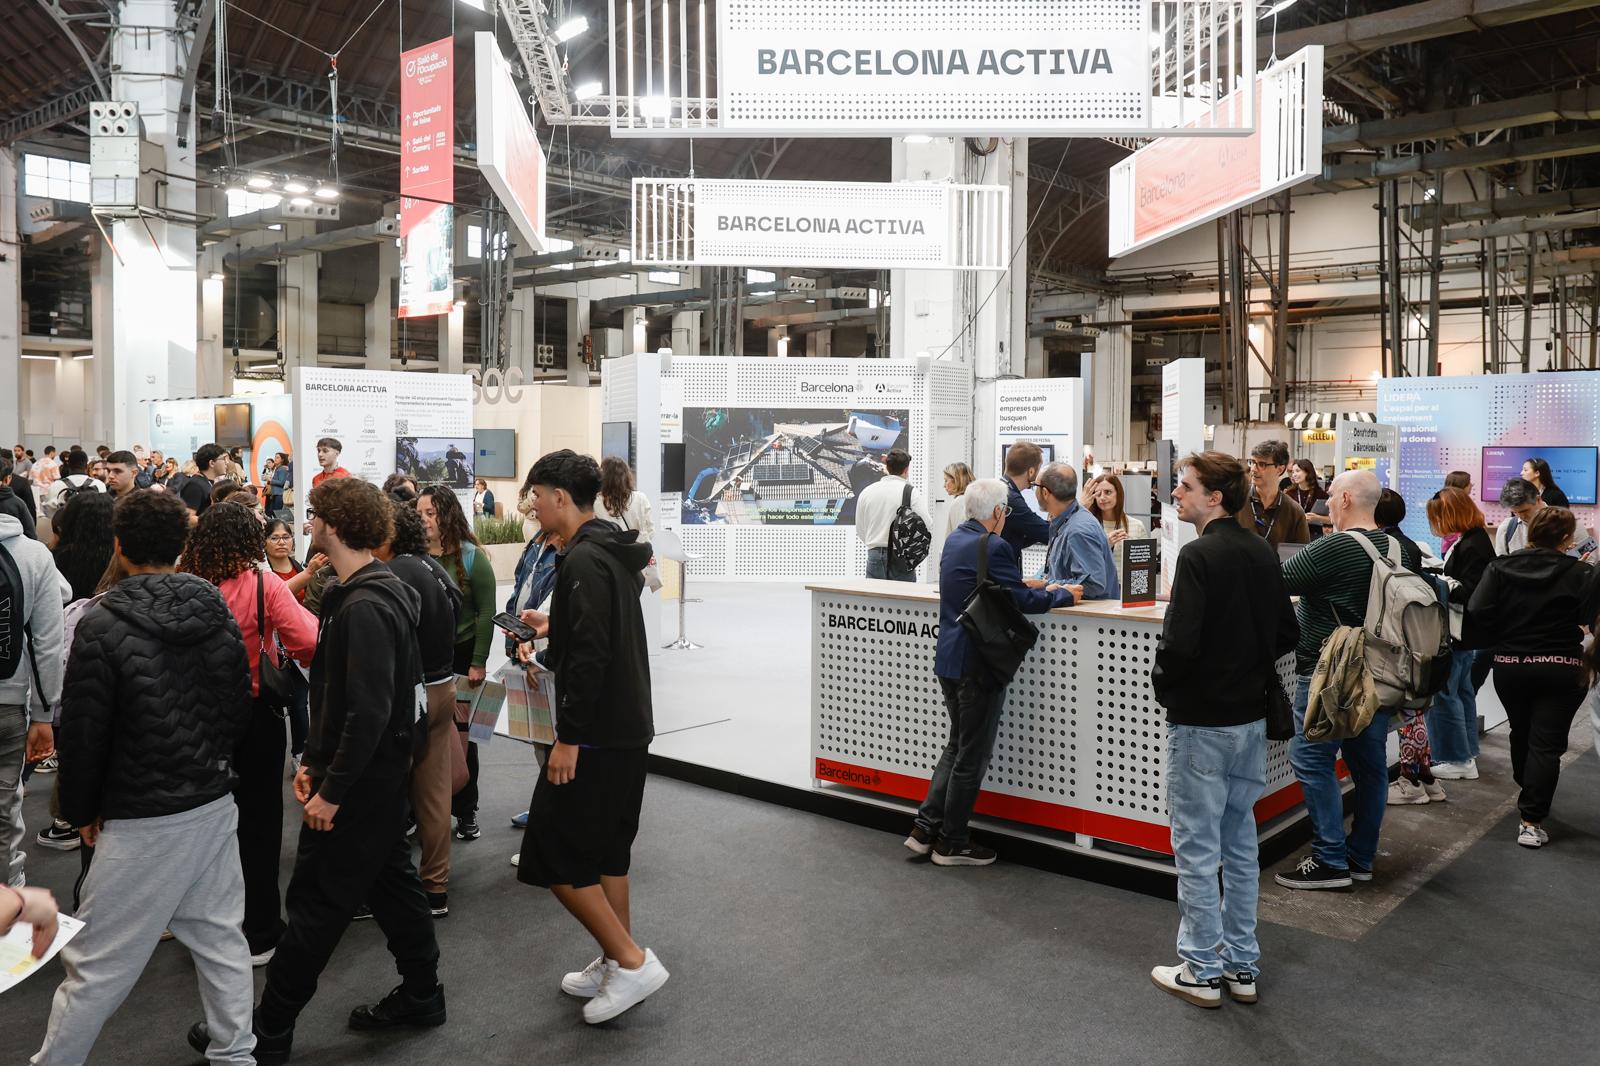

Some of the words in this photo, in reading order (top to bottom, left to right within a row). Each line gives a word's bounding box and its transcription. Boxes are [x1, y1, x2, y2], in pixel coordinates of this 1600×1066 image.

[430, 52, 438, 61] de
[757, 48, 970, 76] BARCELONA
[976, 48, 1114, 76] ACTIVA
[1140, 171, 1186, 209] Barcelona
[716, 215, 841, 234] BARCELONA
[844, 218, 925, 236] ACTIVA
[305, 383, 356, 392] BARCELONA
[355, 384, 388, 394] ACTIVA
[800, 381, 854, 393] Barcelona
[999, 395, 1032, 403] Connecta
[999, 425, 1043, 433] professionals
[828, 613, 918, 637] BARCELONA
[1522, 654, 1580, 667] ARMOUR
[819, 762, 871, 785] Barcelona
